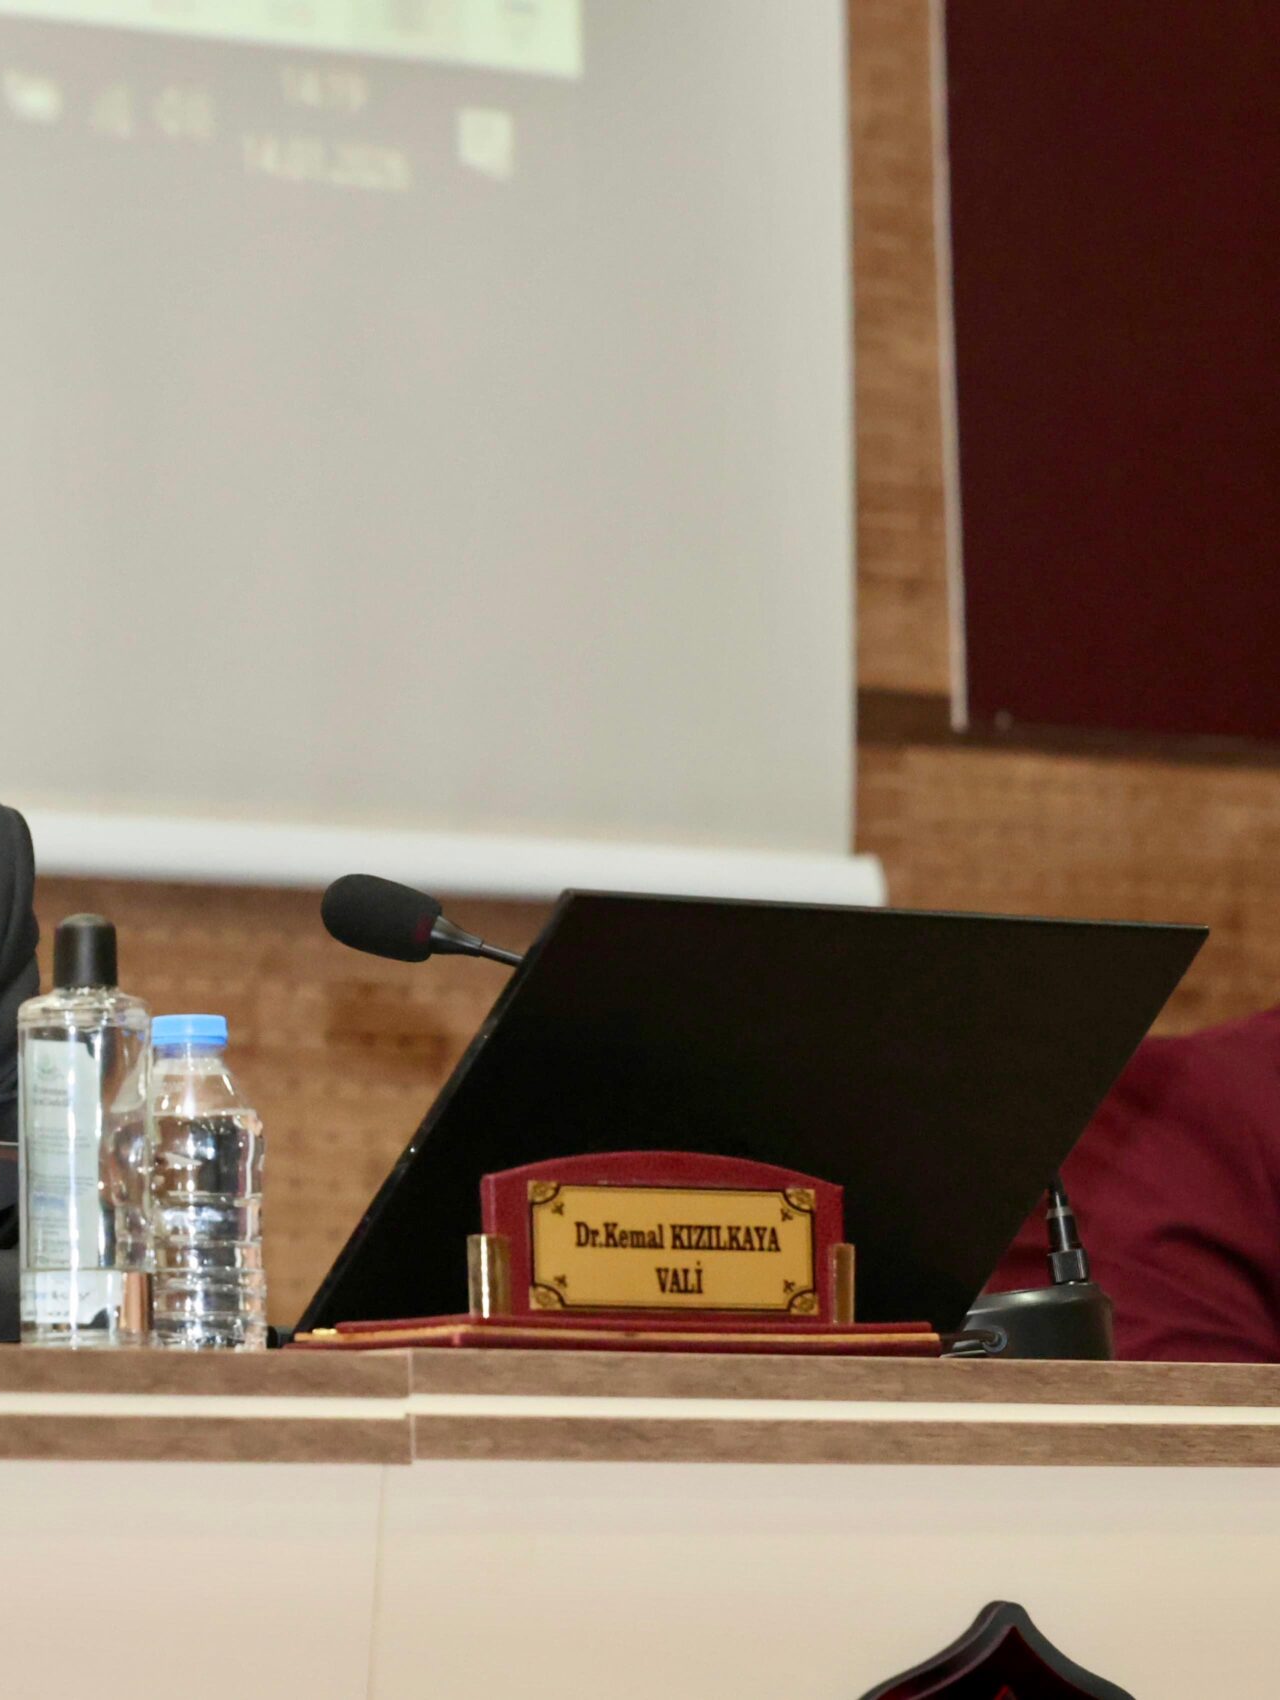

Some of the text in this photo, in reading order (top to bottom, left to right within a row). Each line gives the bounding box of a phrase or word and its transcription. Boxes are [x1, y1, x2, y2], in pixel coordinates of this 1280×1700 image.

[574, 1220, 782, 1253] Dr.Kemal KIZILKAYA
[654, 1260, 704, 1295] VALİ
